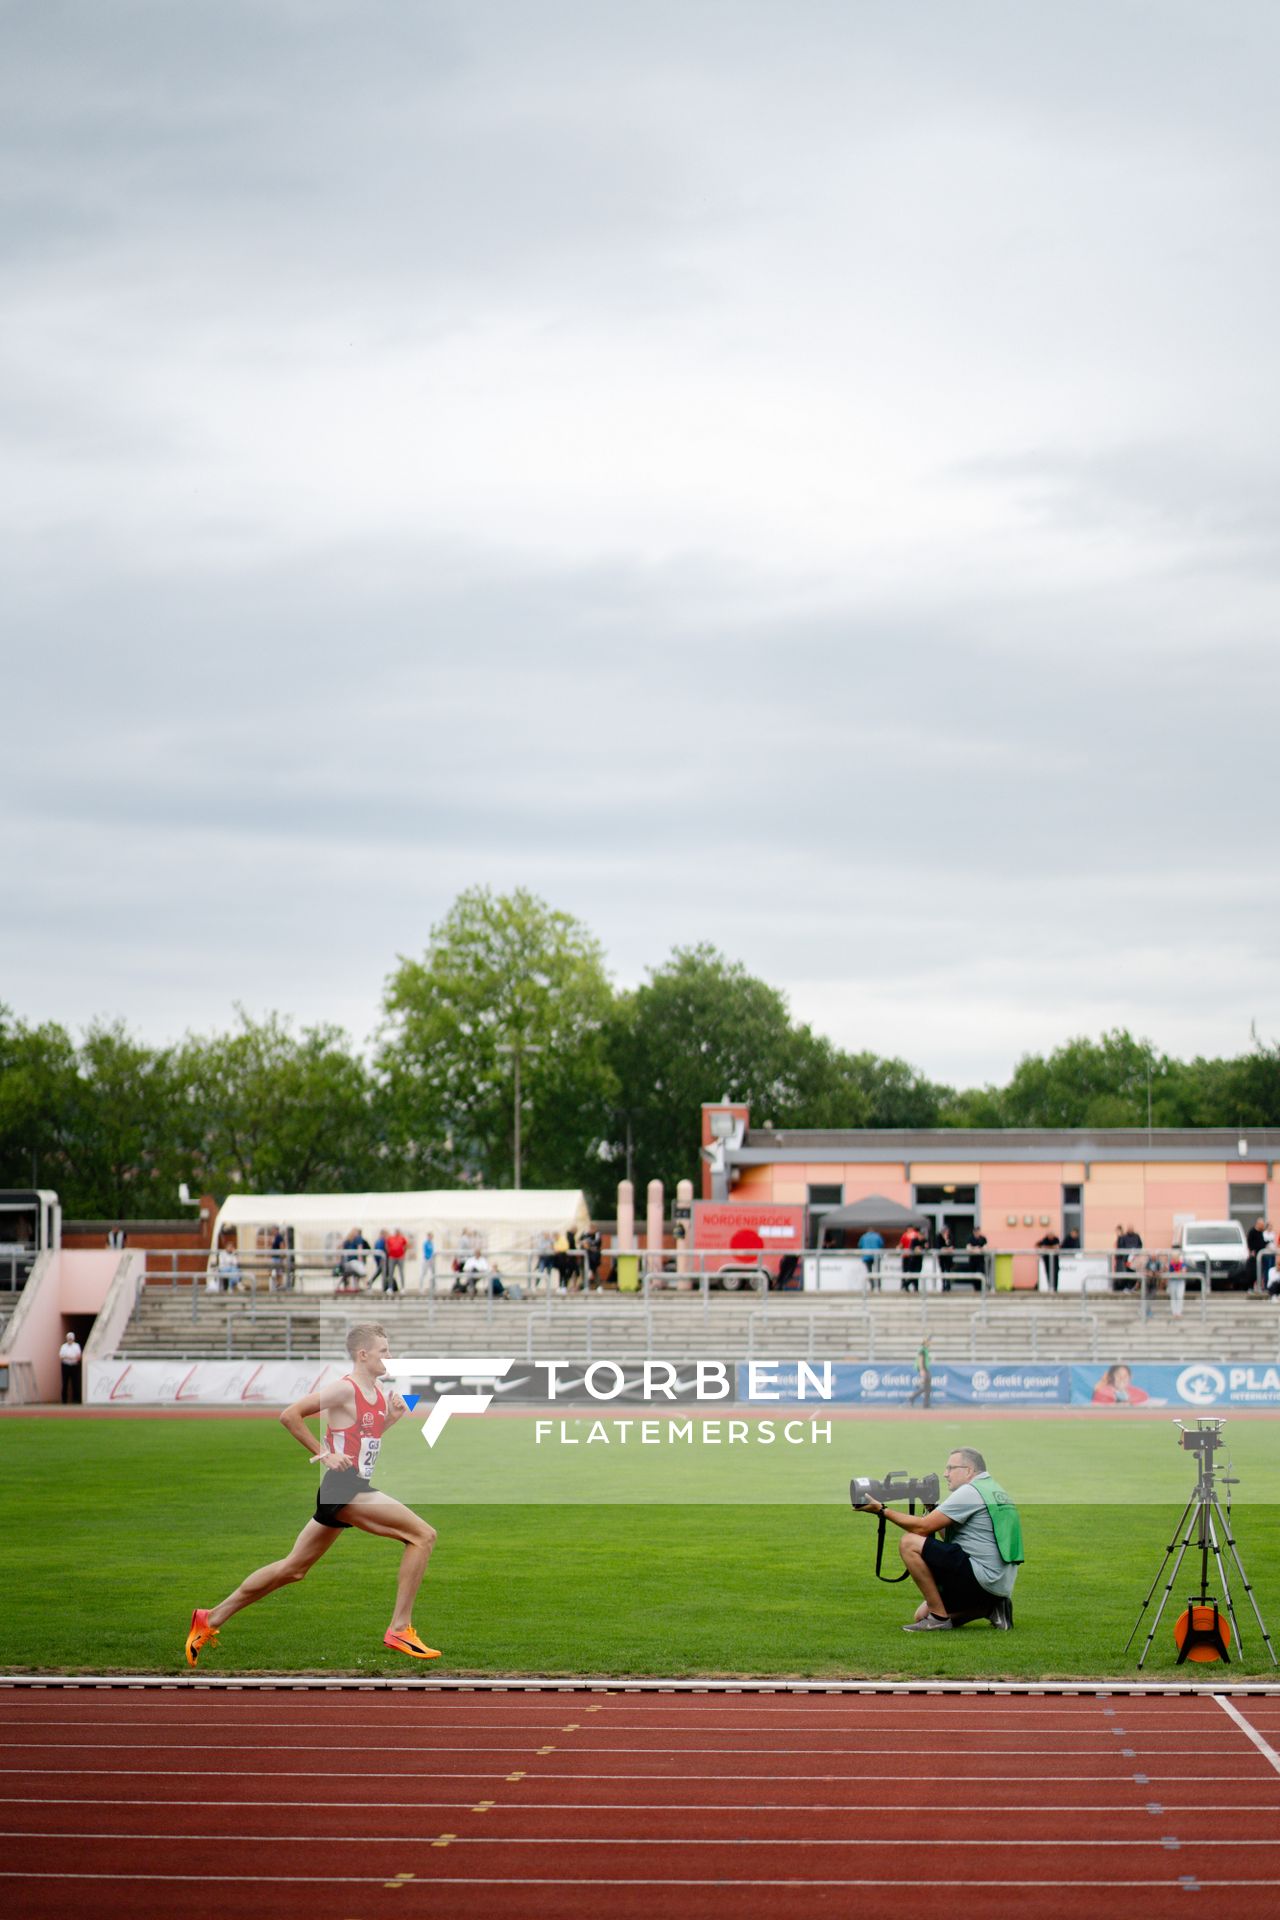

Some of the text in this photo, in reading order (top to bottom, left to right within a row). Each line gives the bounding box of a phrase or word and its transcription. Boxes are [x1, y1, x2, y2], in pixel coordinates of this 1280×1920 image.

[703, 1214, 792, 1226] NORDENBROCK
[993, 1375, 1021, 1387] direkt
[1023, 1376, 1059, 1389] gesund
